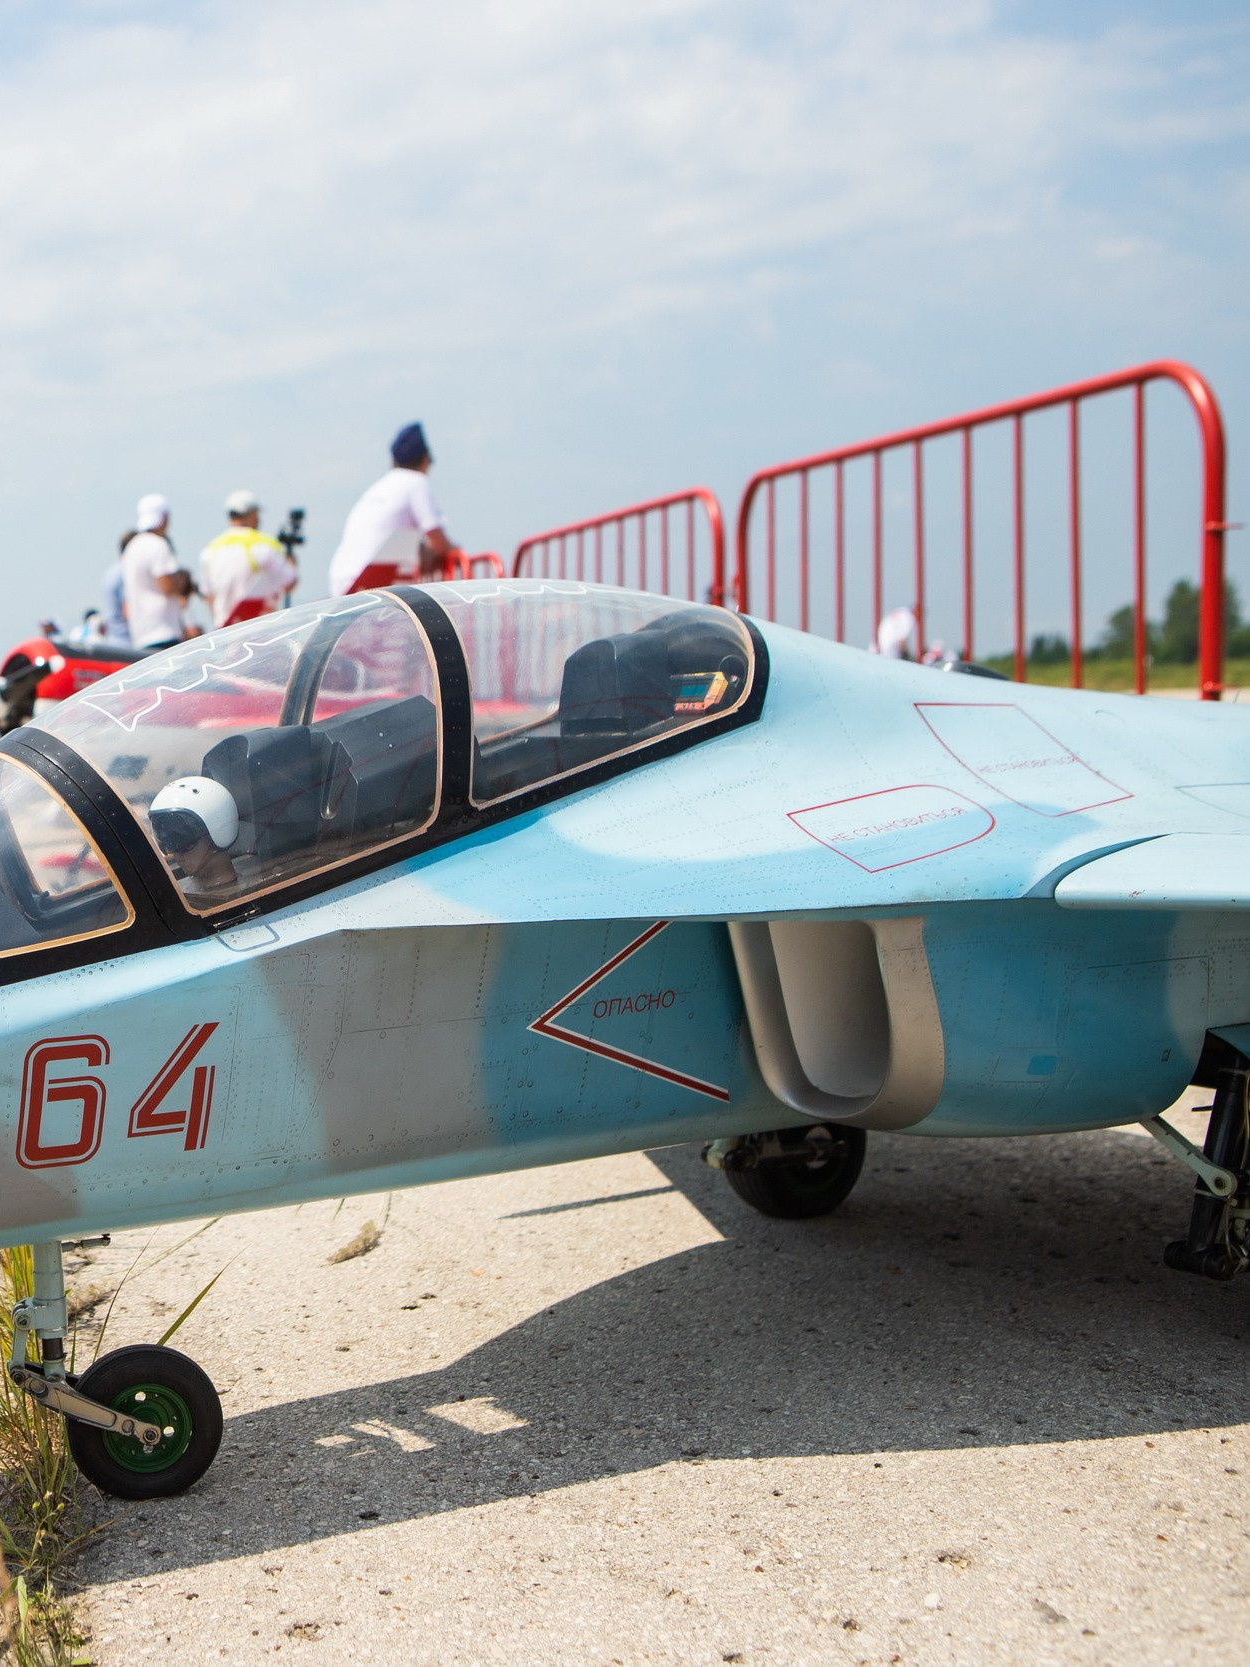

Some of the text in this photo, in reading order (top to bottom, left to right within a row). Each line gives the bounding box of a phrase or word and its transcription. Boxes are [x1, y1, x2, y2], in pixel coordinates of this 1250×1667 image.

[826, 806, 967, 843] НЕ СТАНОВИТЬСЯ
[593, 990, 675, 1019] ОПАСНО
[15, 1021, 221, 1170] 64
